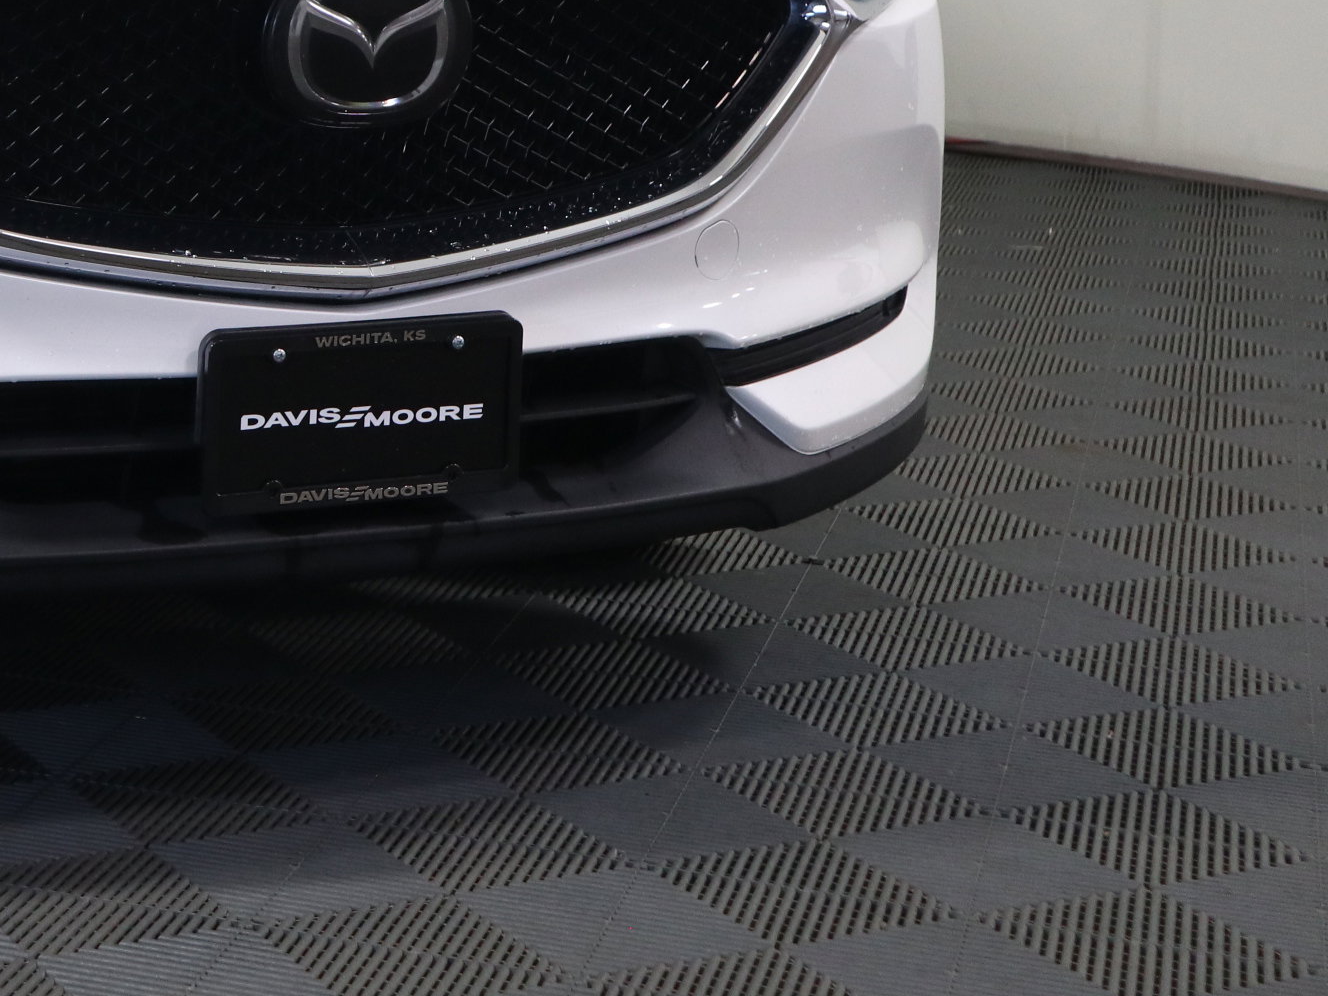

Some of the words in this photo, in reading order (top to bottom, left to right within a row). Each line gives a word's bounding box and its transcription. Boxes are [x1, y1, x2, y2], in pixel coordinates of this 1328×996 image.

[314, 331, 398, 348] WICHITA,
[403, 329, 427, 343] KS
[240, 407, 341, 432] DAVIS
[363, 402, 484, 429] MOORE
[279, 487, 350, 506] DAVIS
[364, 481, 449, 502] MOORE
